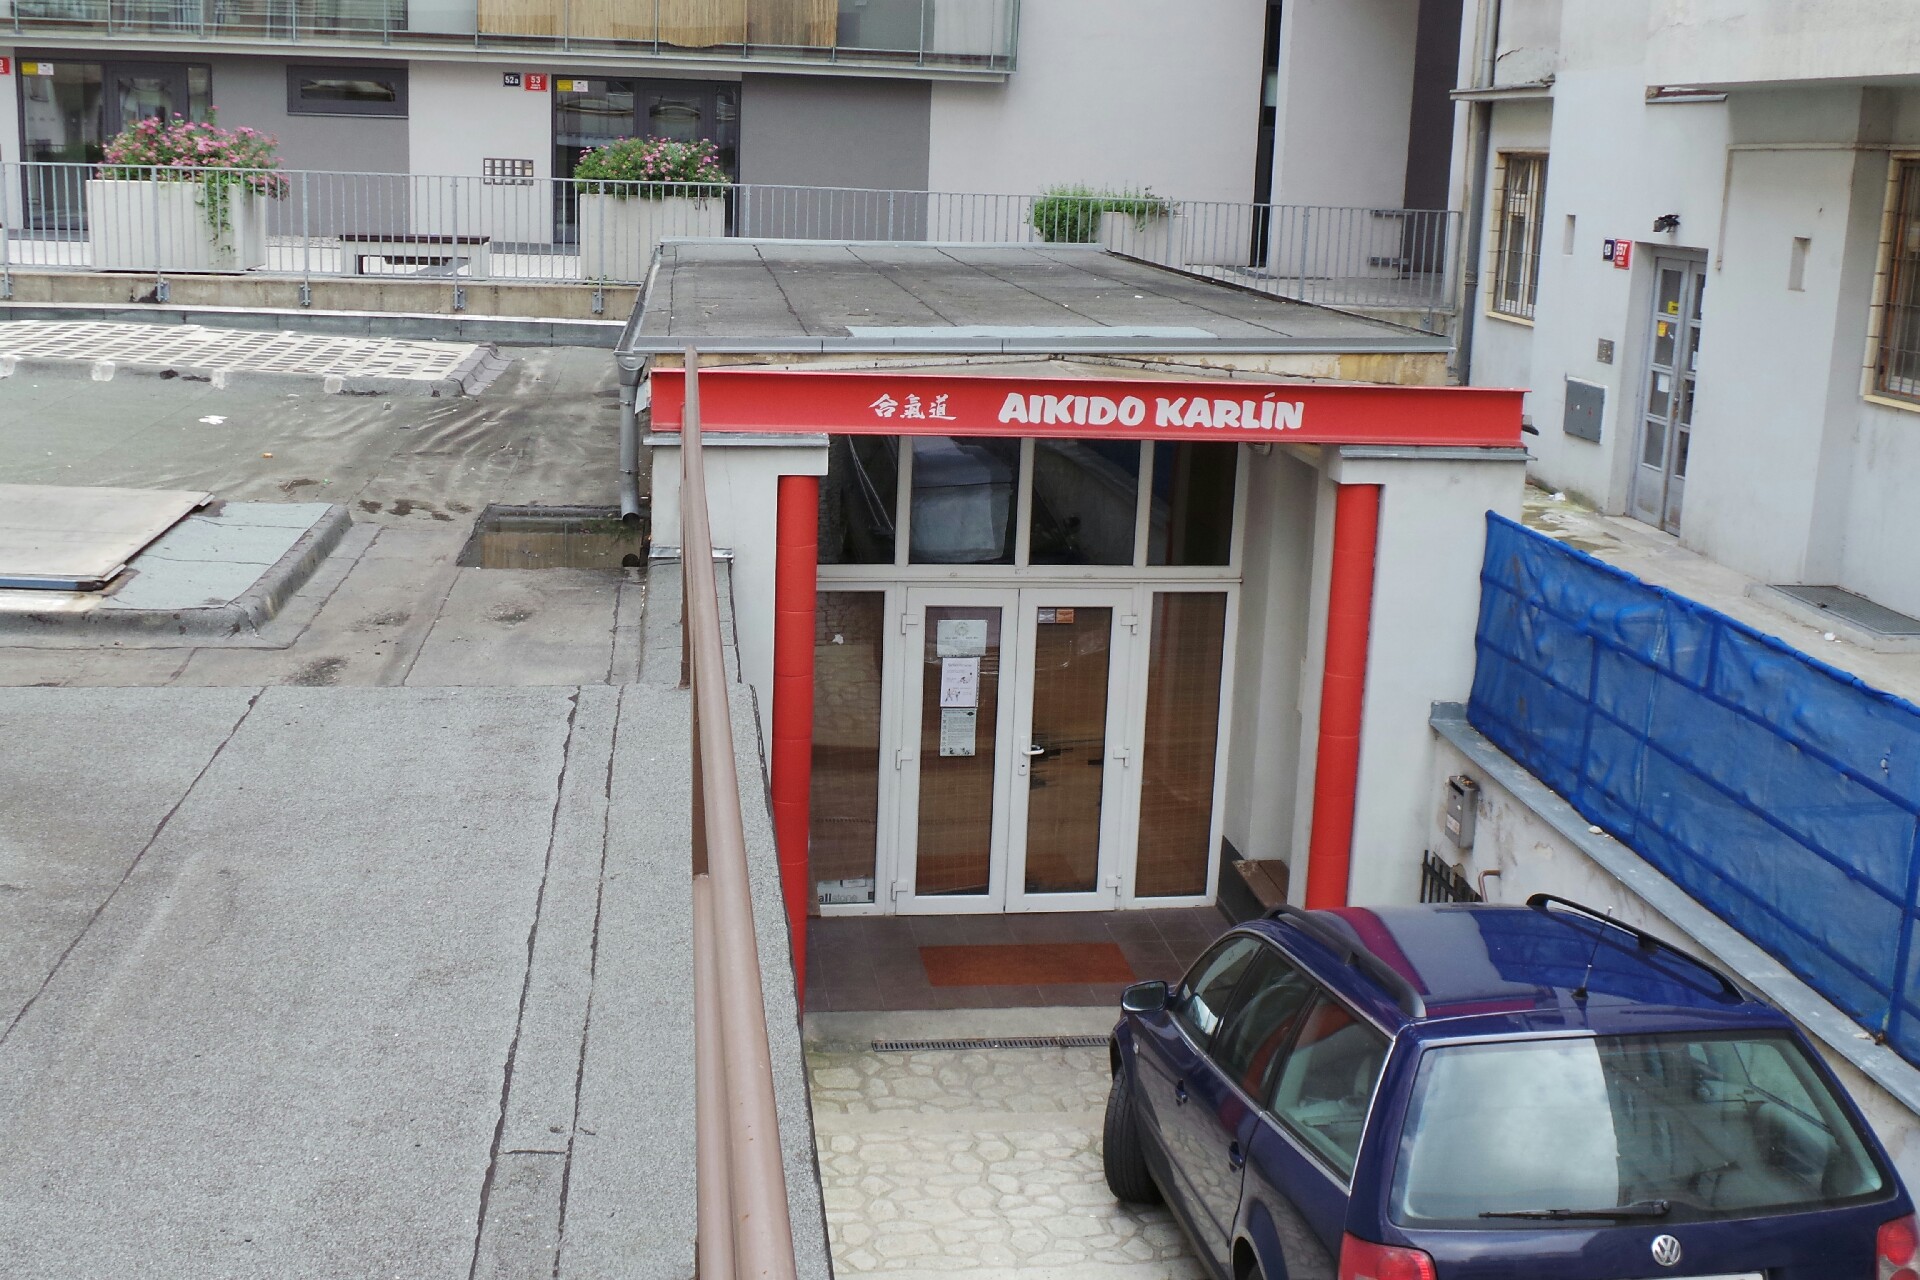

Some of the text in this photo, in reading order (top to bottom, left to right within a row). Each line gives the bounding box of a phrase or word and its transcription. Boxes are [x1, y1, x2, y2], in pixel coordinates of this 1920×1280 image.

[505, 75, 519, 84] 52a
[530, 75, 541, 84] 53
[868, 392, 957, 421] 合氣道
[997, 392, 1305, 430] AIKIDO KARLÍN
